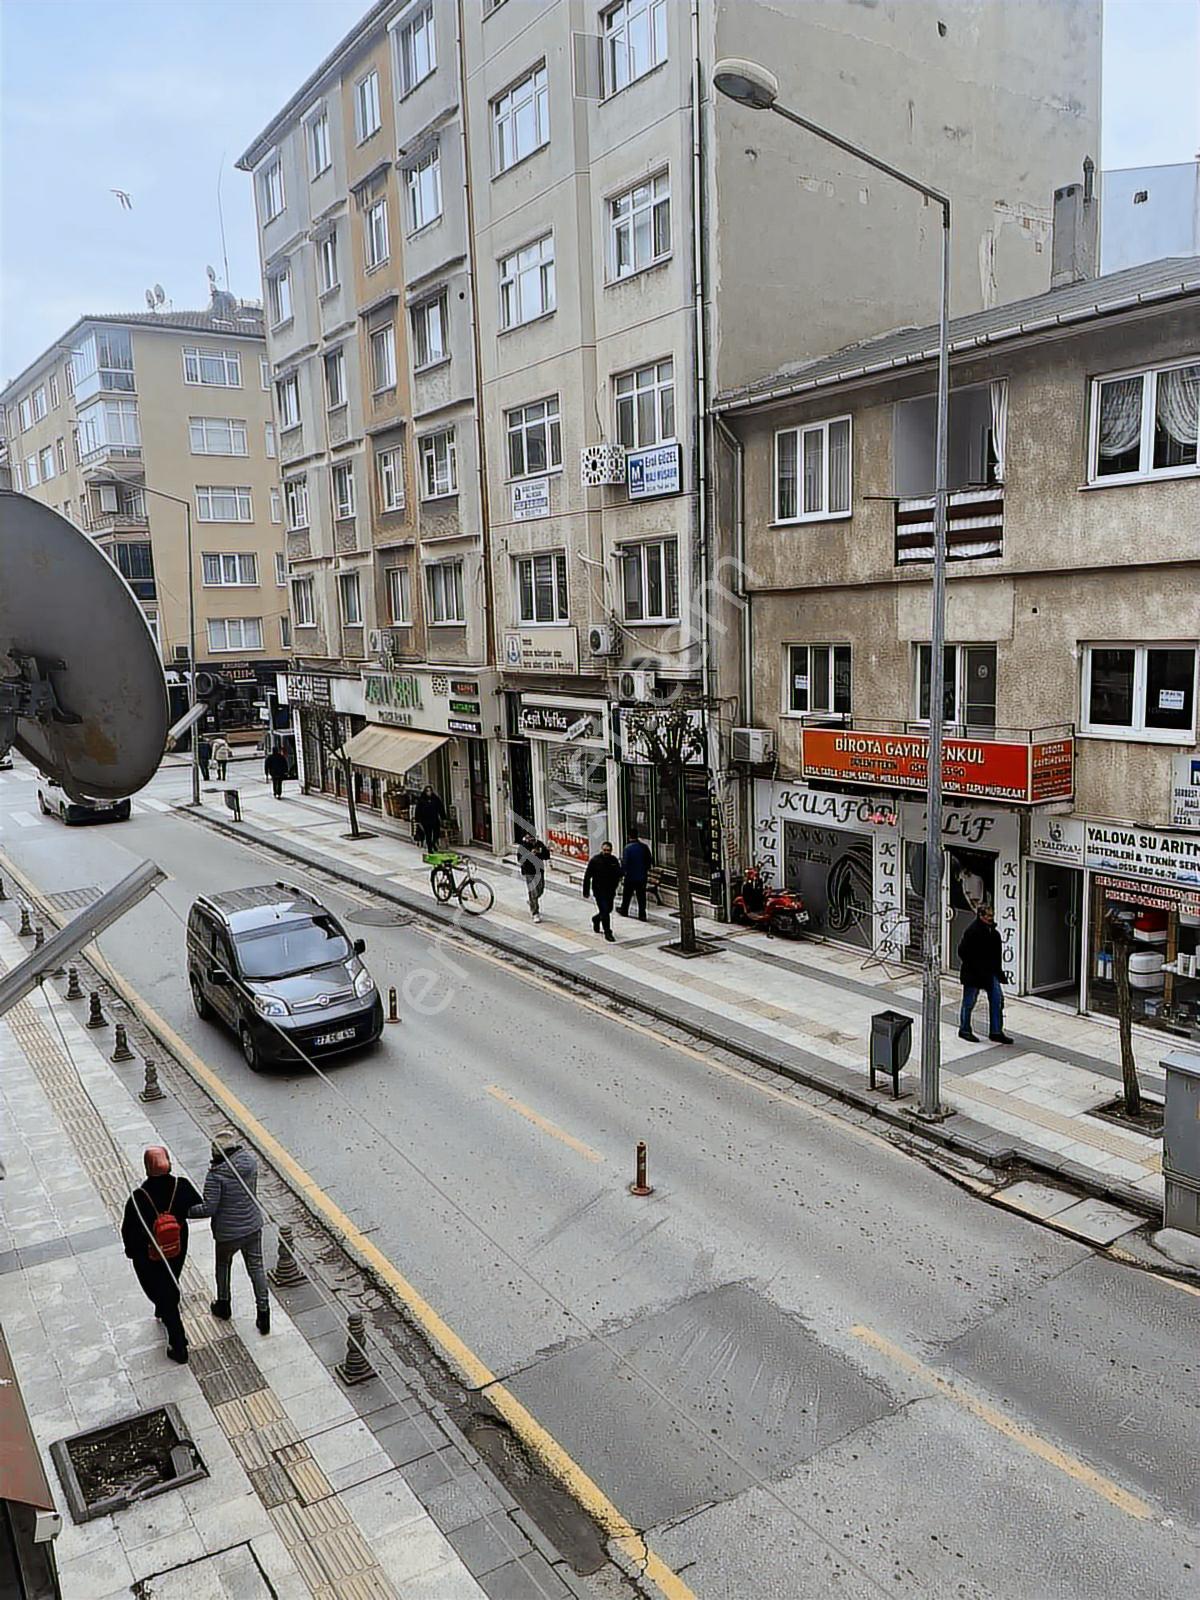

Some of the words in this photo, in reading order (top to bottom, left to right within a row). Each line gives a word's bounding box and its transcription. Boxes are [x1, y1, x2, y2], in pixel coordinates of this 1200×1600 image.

[835, 733, 882, 755] BİROTA
[885, 739, 985, 764] GAYRİENKUL
[1087, 827, 1136, 848] YALOVA
[1139, 836, 1157, 849] SU
